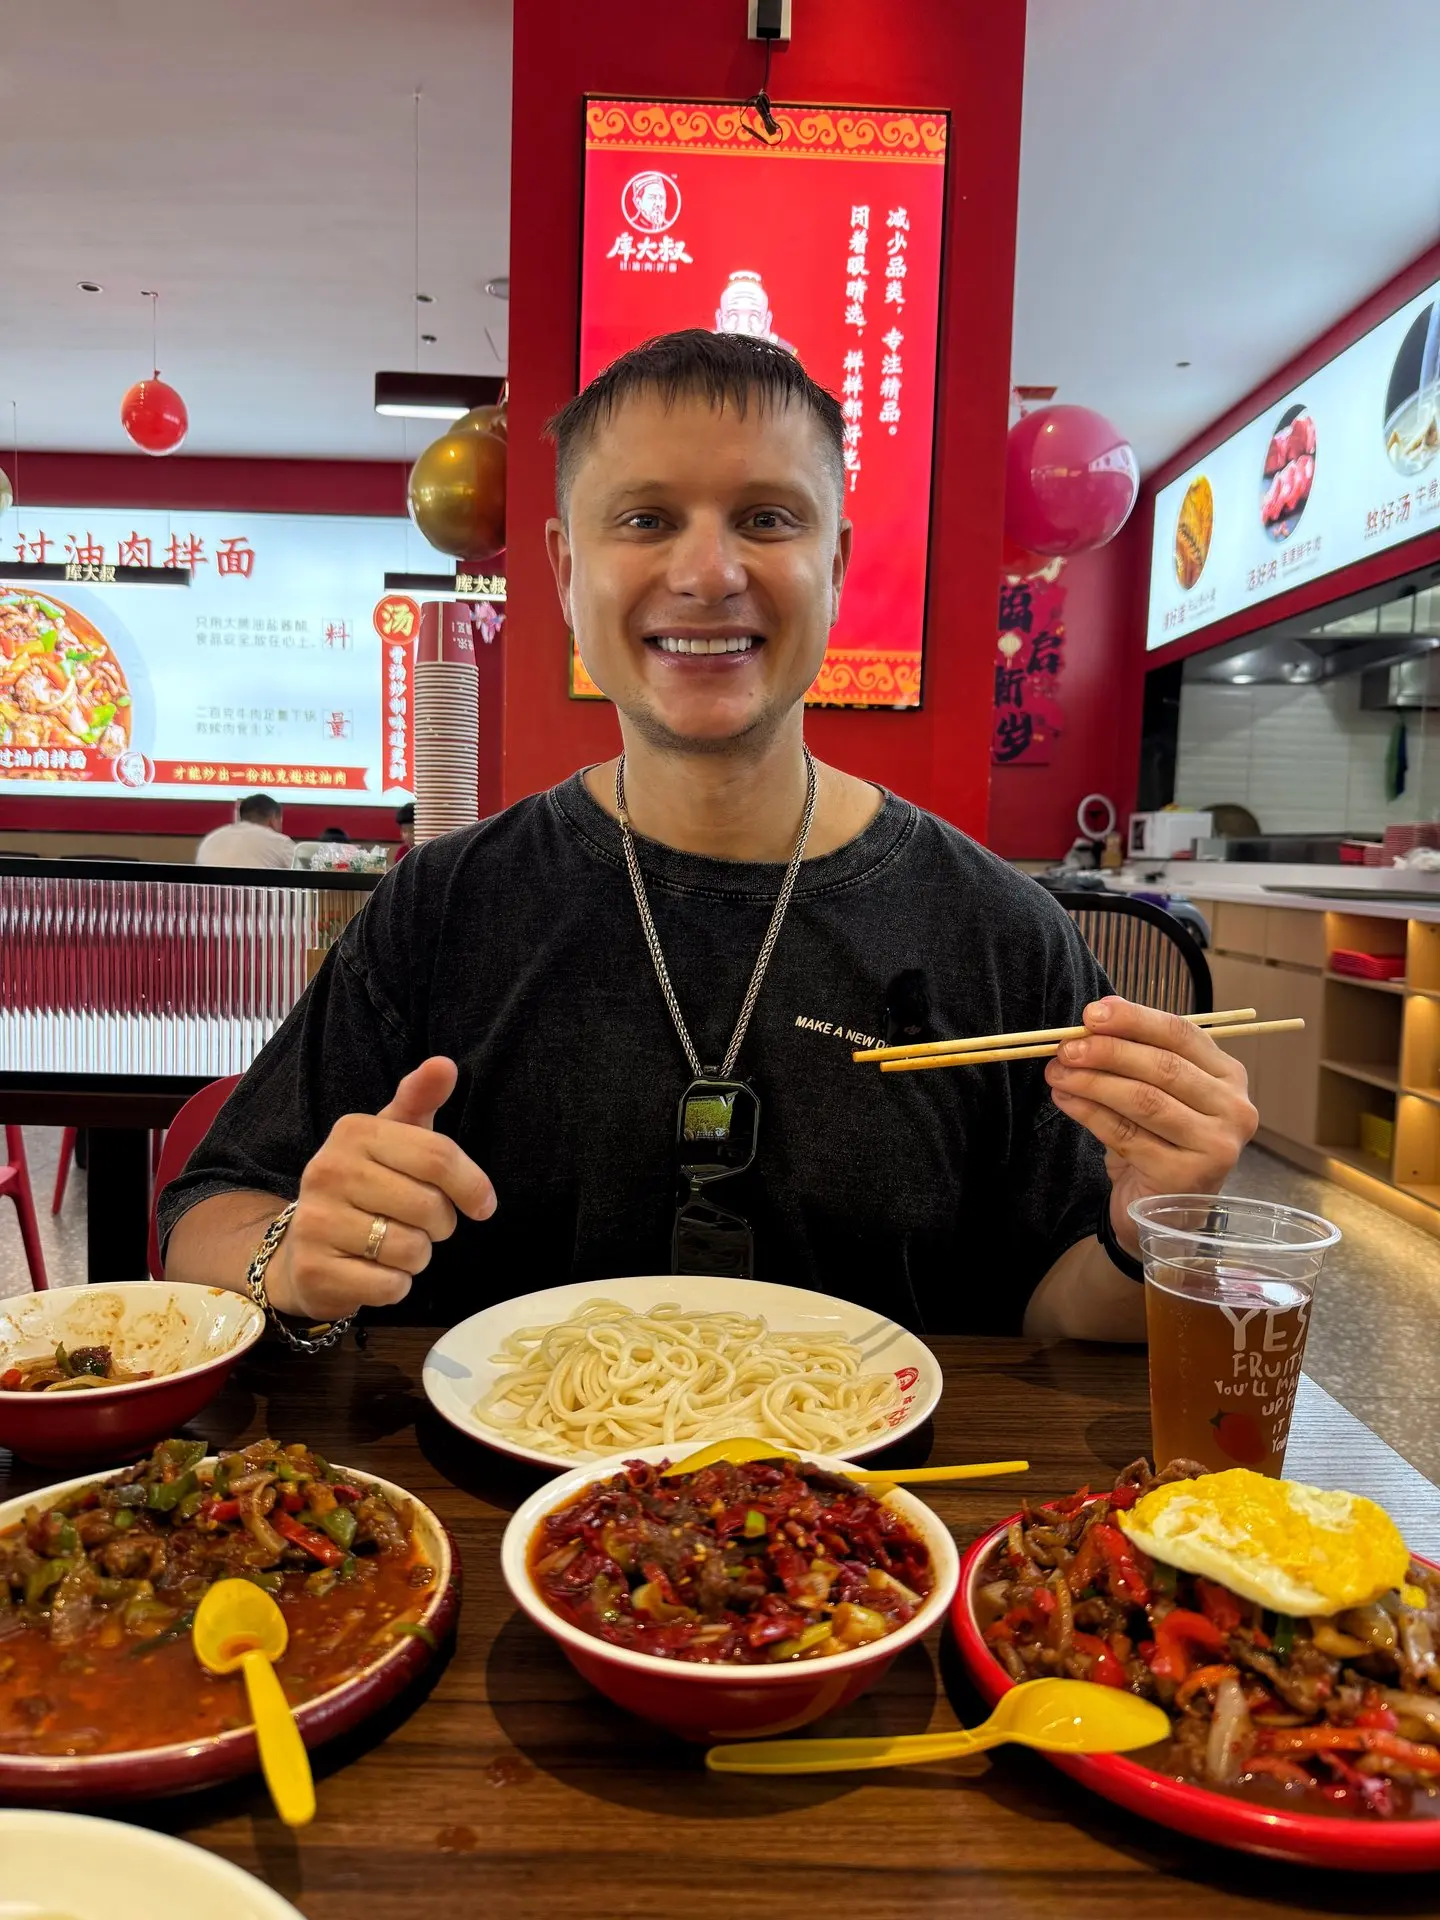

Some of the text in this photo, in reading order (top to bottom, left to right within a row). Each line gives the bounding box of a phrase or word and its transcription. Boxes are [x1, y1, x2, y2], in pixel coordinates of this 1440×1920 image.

[606, 232, 694, 264] 库大叔
[13, 529, 256, 580] 过油肉拌面
[65, 564, 116, 582] 库大叔
[456, 573, 507, 594] 库大叔
[325, 619, 350, 649] 料
[382, 604, 414, 636] 汤
[326, 711, 351, 738] 量
[0, 748, 87, 769] 过油肉拌面
[795, 1015, 833, 1034] MAKE
[833, 1026, 843, 1038] A
[845, 1029, 875, 1048] NEW
[1219, 1303, 1307, 1352] YES
